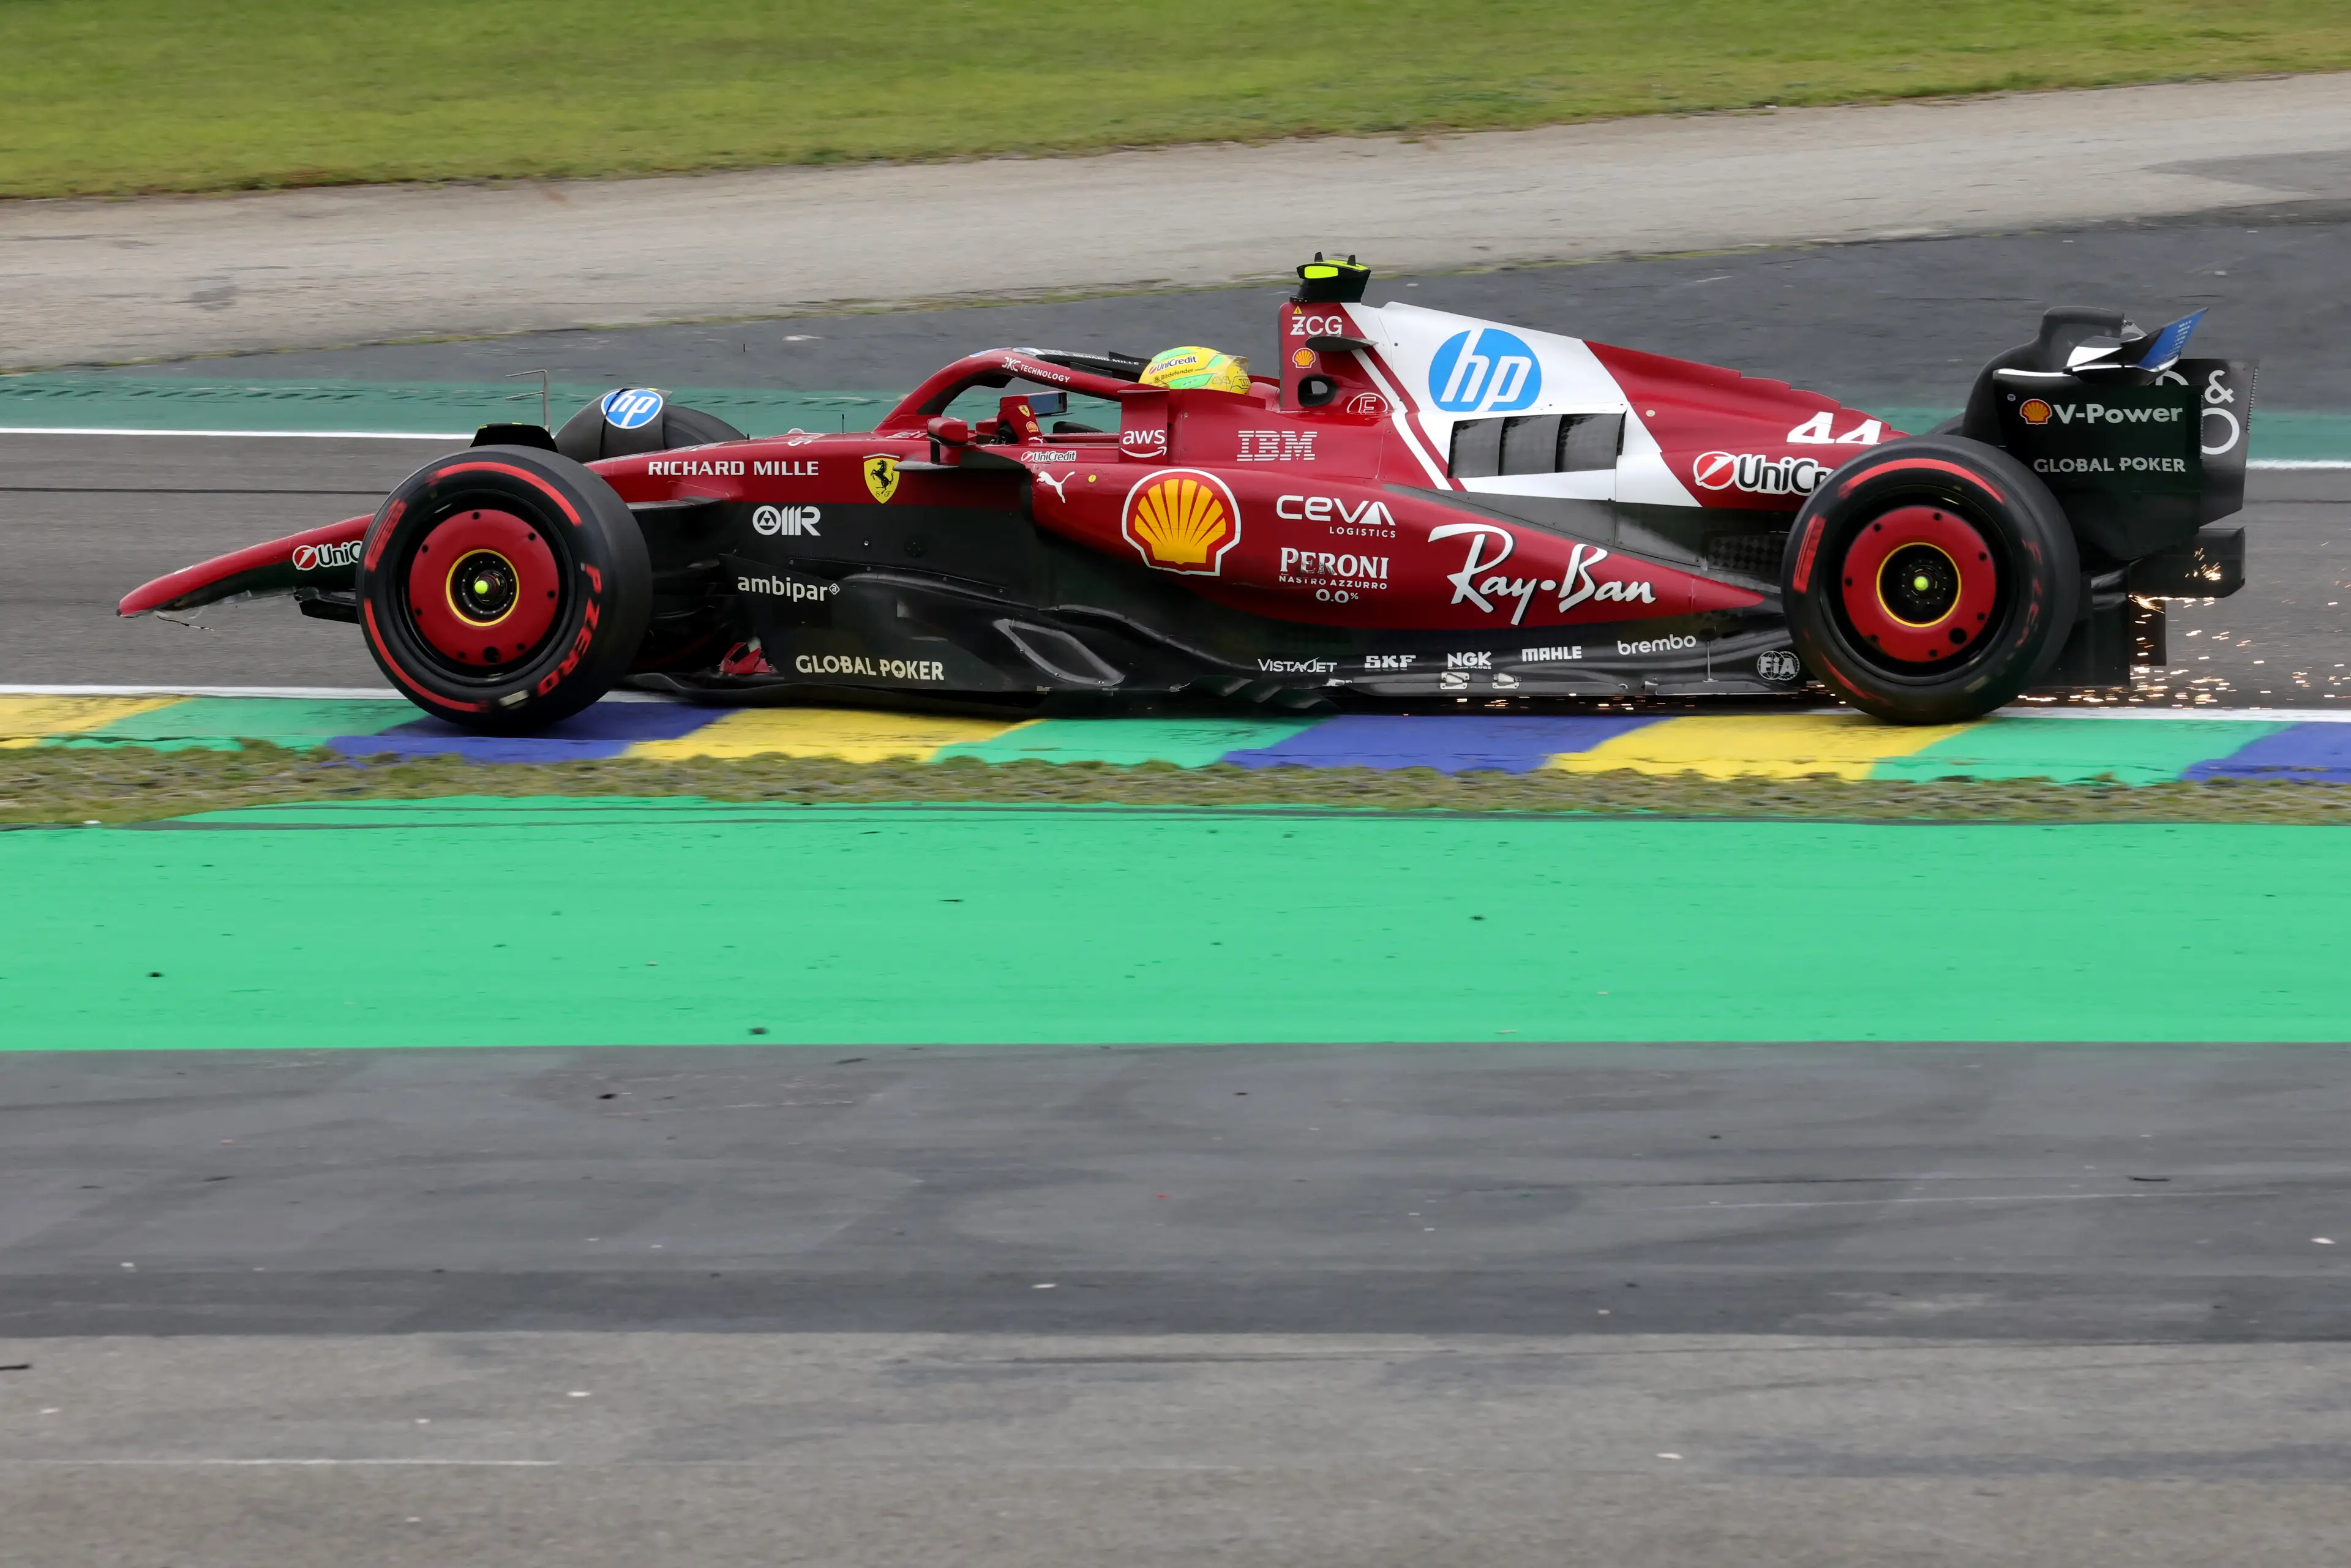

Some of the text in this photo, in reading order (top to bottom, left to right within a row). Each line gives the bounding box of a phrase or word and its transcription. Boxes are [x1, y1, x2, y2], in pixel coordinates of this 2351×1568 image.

[1156, 356, 1198, 372] UniCredit
[1440, 329, 1532, 411] hp
[1021, 364, 1071, 383] TECHNOLOGY
[1161, 368, 1194, 380] Bitdefender
[607, 389, 658, 428] hp
[2053, 403, 2183, 424] V-Power
[1786, 411, 1882, 445] 44
[1122, 429, 1166, 445] aws
[1237, 430, 1318, 462] IBM
[1033, 450, 1076, 462] UniCredit
[648, 460, 819, 476] RICHARD MILLE
[2033, 457, 2186, 473] GLOBAL POKER
[1329, 527, 1397, 538] LOGISTICS
[1280, 547, 1389, 579] PERONI
[737, 576, 827, 602] ambipar
[1279, 575, 1387, 590] NASTRO AZZURRO
[1316, 588, 1359, 603] 0.0%
[1617, 634, 1697, 655] brembo
[1365, 655, 1416, 669] SKF
[1447, 651, 1492, 667] NGK
[1522, 646, 1582, 662] MAHLE
[796, 655, 945, 680] GLOBAL POKER
